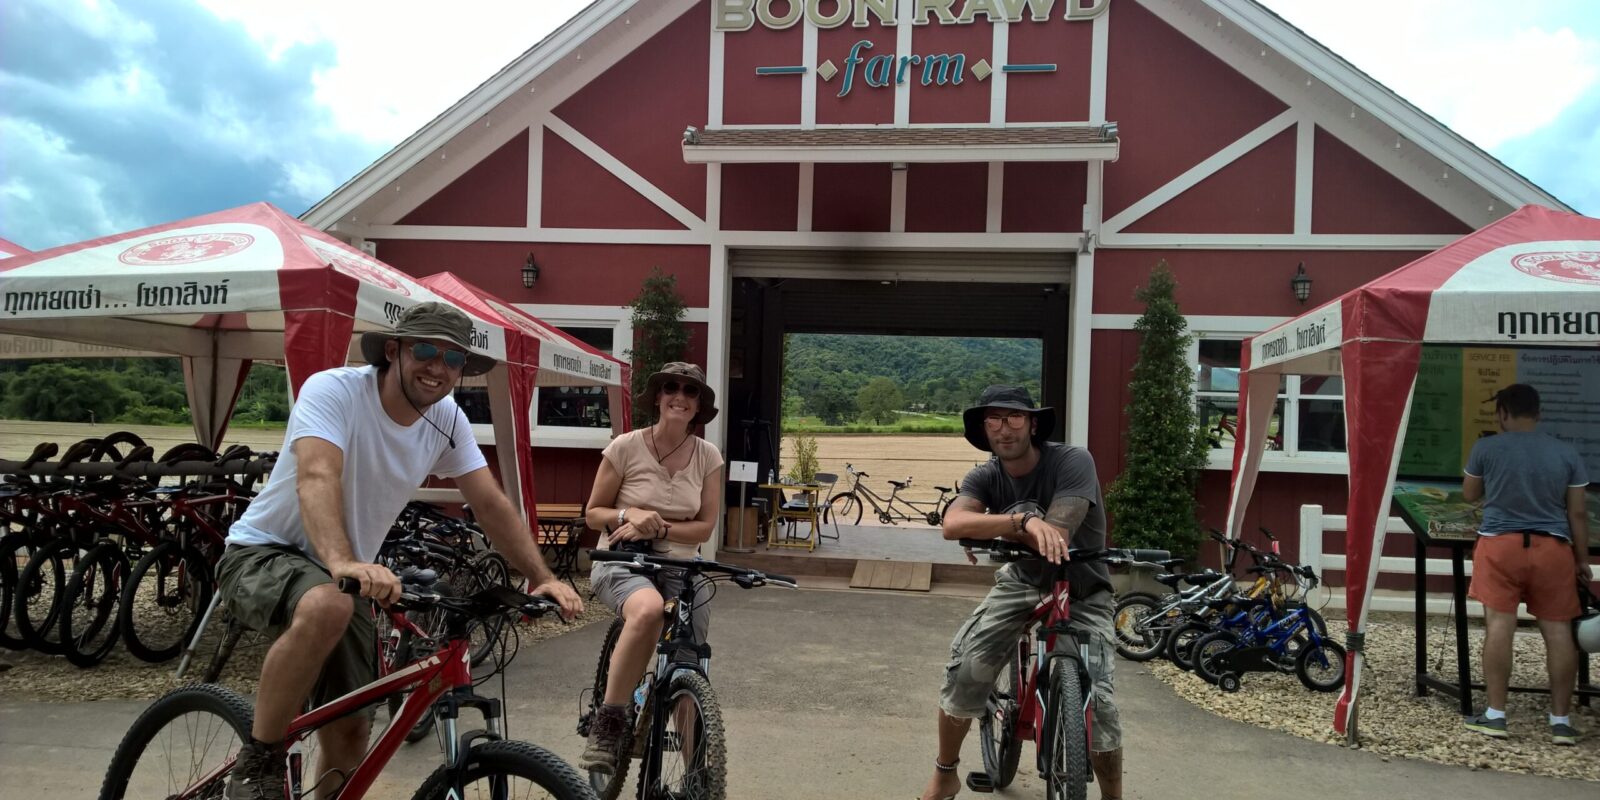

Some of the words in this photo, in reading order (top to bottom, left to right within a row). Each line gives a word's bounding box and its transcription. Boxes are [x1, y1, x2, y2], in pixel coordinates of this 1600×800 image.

[714, 0, 898, 32] BOON
[912, 0, 1110, 25] RAWD
[837, 39, 966, 97] farm
[136, 278, 230, 307] โซดาสิงห์
[470, 327, 488, 350] สิงห์
